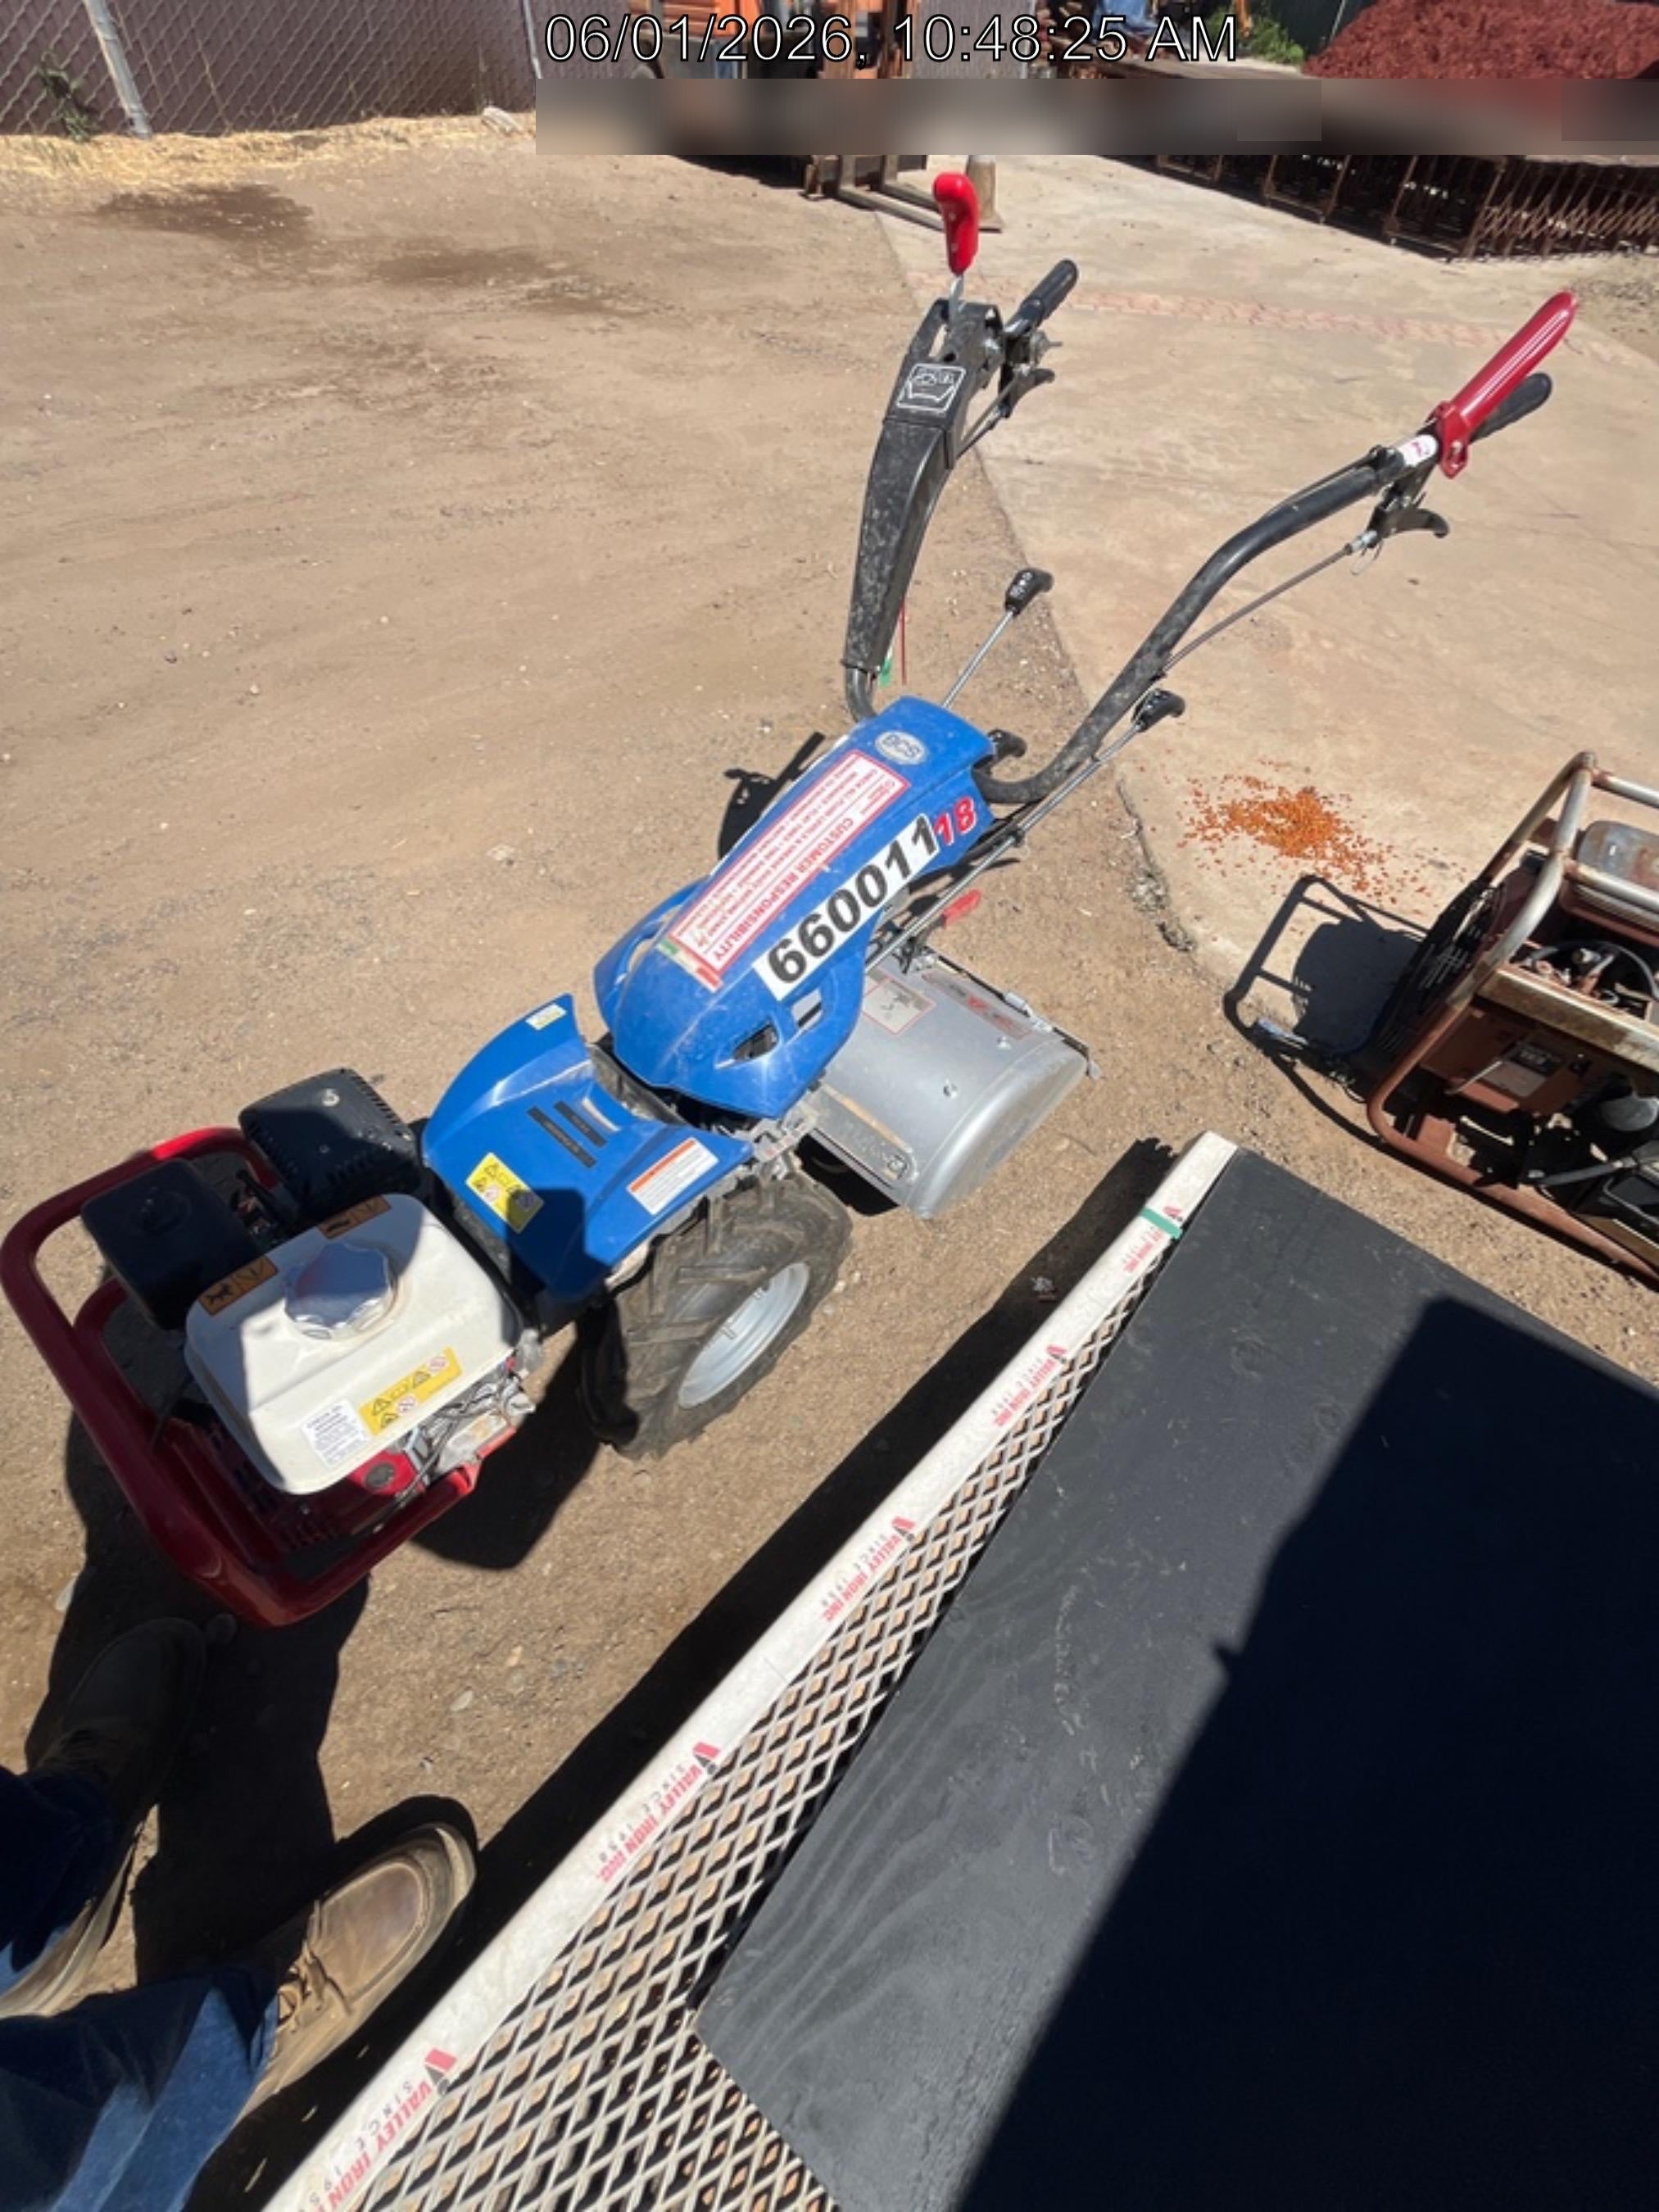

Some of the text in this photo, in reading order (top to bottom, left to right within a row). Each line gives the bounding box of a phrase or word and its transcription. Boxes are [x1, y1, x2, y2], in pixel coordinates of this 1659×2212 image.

[886, 737, 920, 758] BCS
[794, 816, 855, 874] CUSTOMER
[938, 797, 976, 845] 18
[710, 871, 800, 961] RESPONSIBILITY
[768, 814, 937, 984] 6600111
[659, 1765, 701, 1814] VALLEY
[327, 2081, 432, 2208] VALLEY IRON
[355, 2081, 413, 2150] SINCE
